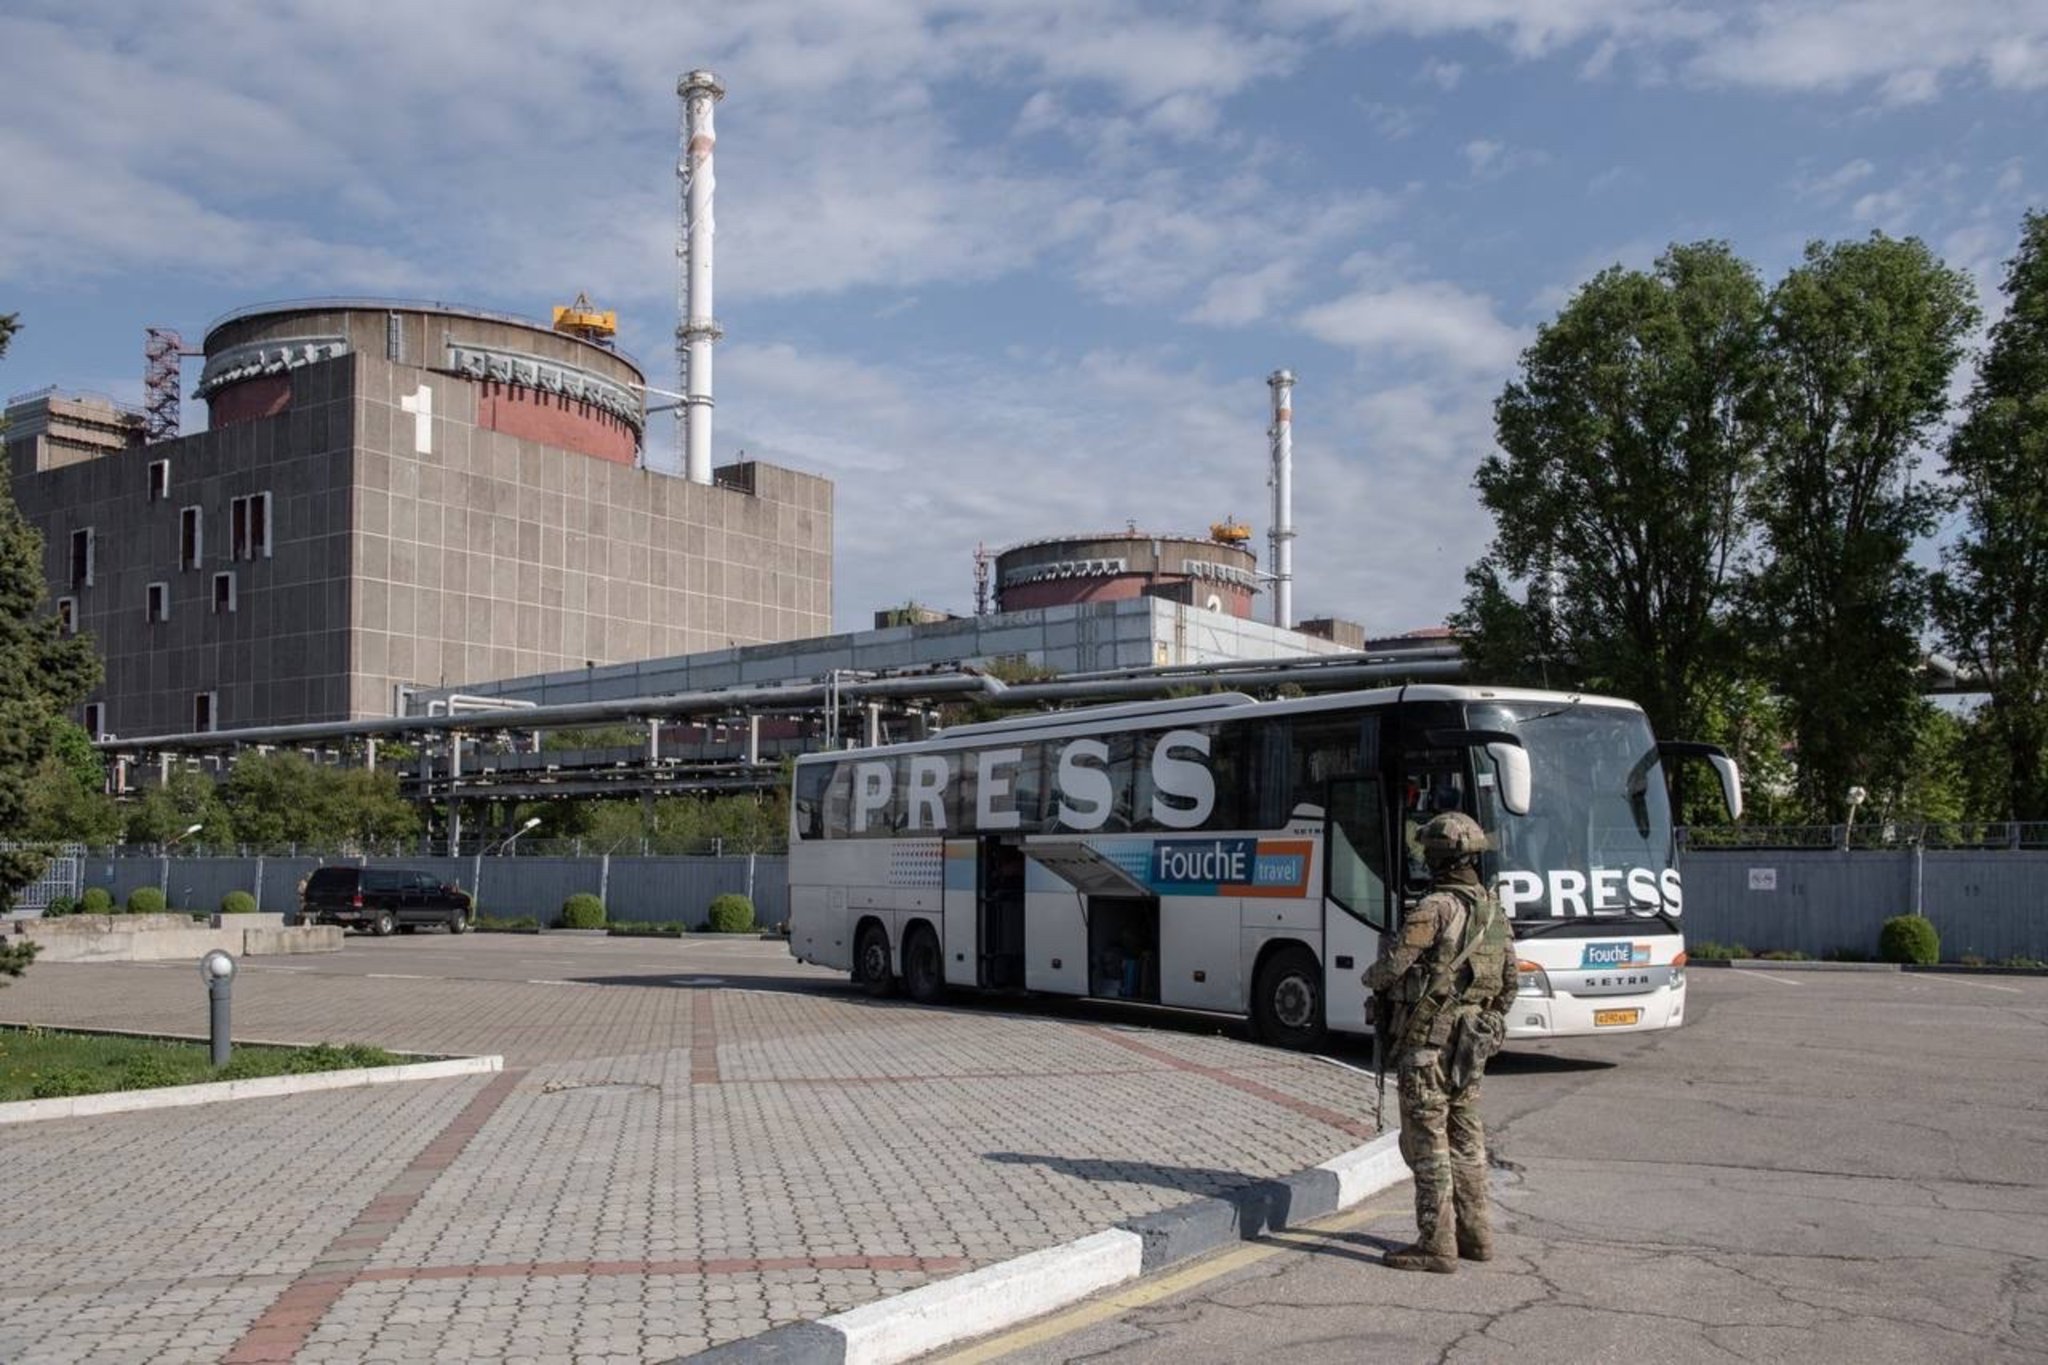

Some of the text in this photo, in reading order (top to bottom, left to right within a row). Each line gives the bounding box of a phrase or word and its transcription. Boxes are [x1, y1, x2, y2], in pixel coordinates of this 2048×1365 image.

[401, 384, 432, 454] 1
[853, 729, 1216, 833] PRESS
[1258, 860, 1296, 880] travel
[1498, 867, 1682, 918] PRESS
[1585, 975, 1649, 987] SETRA
